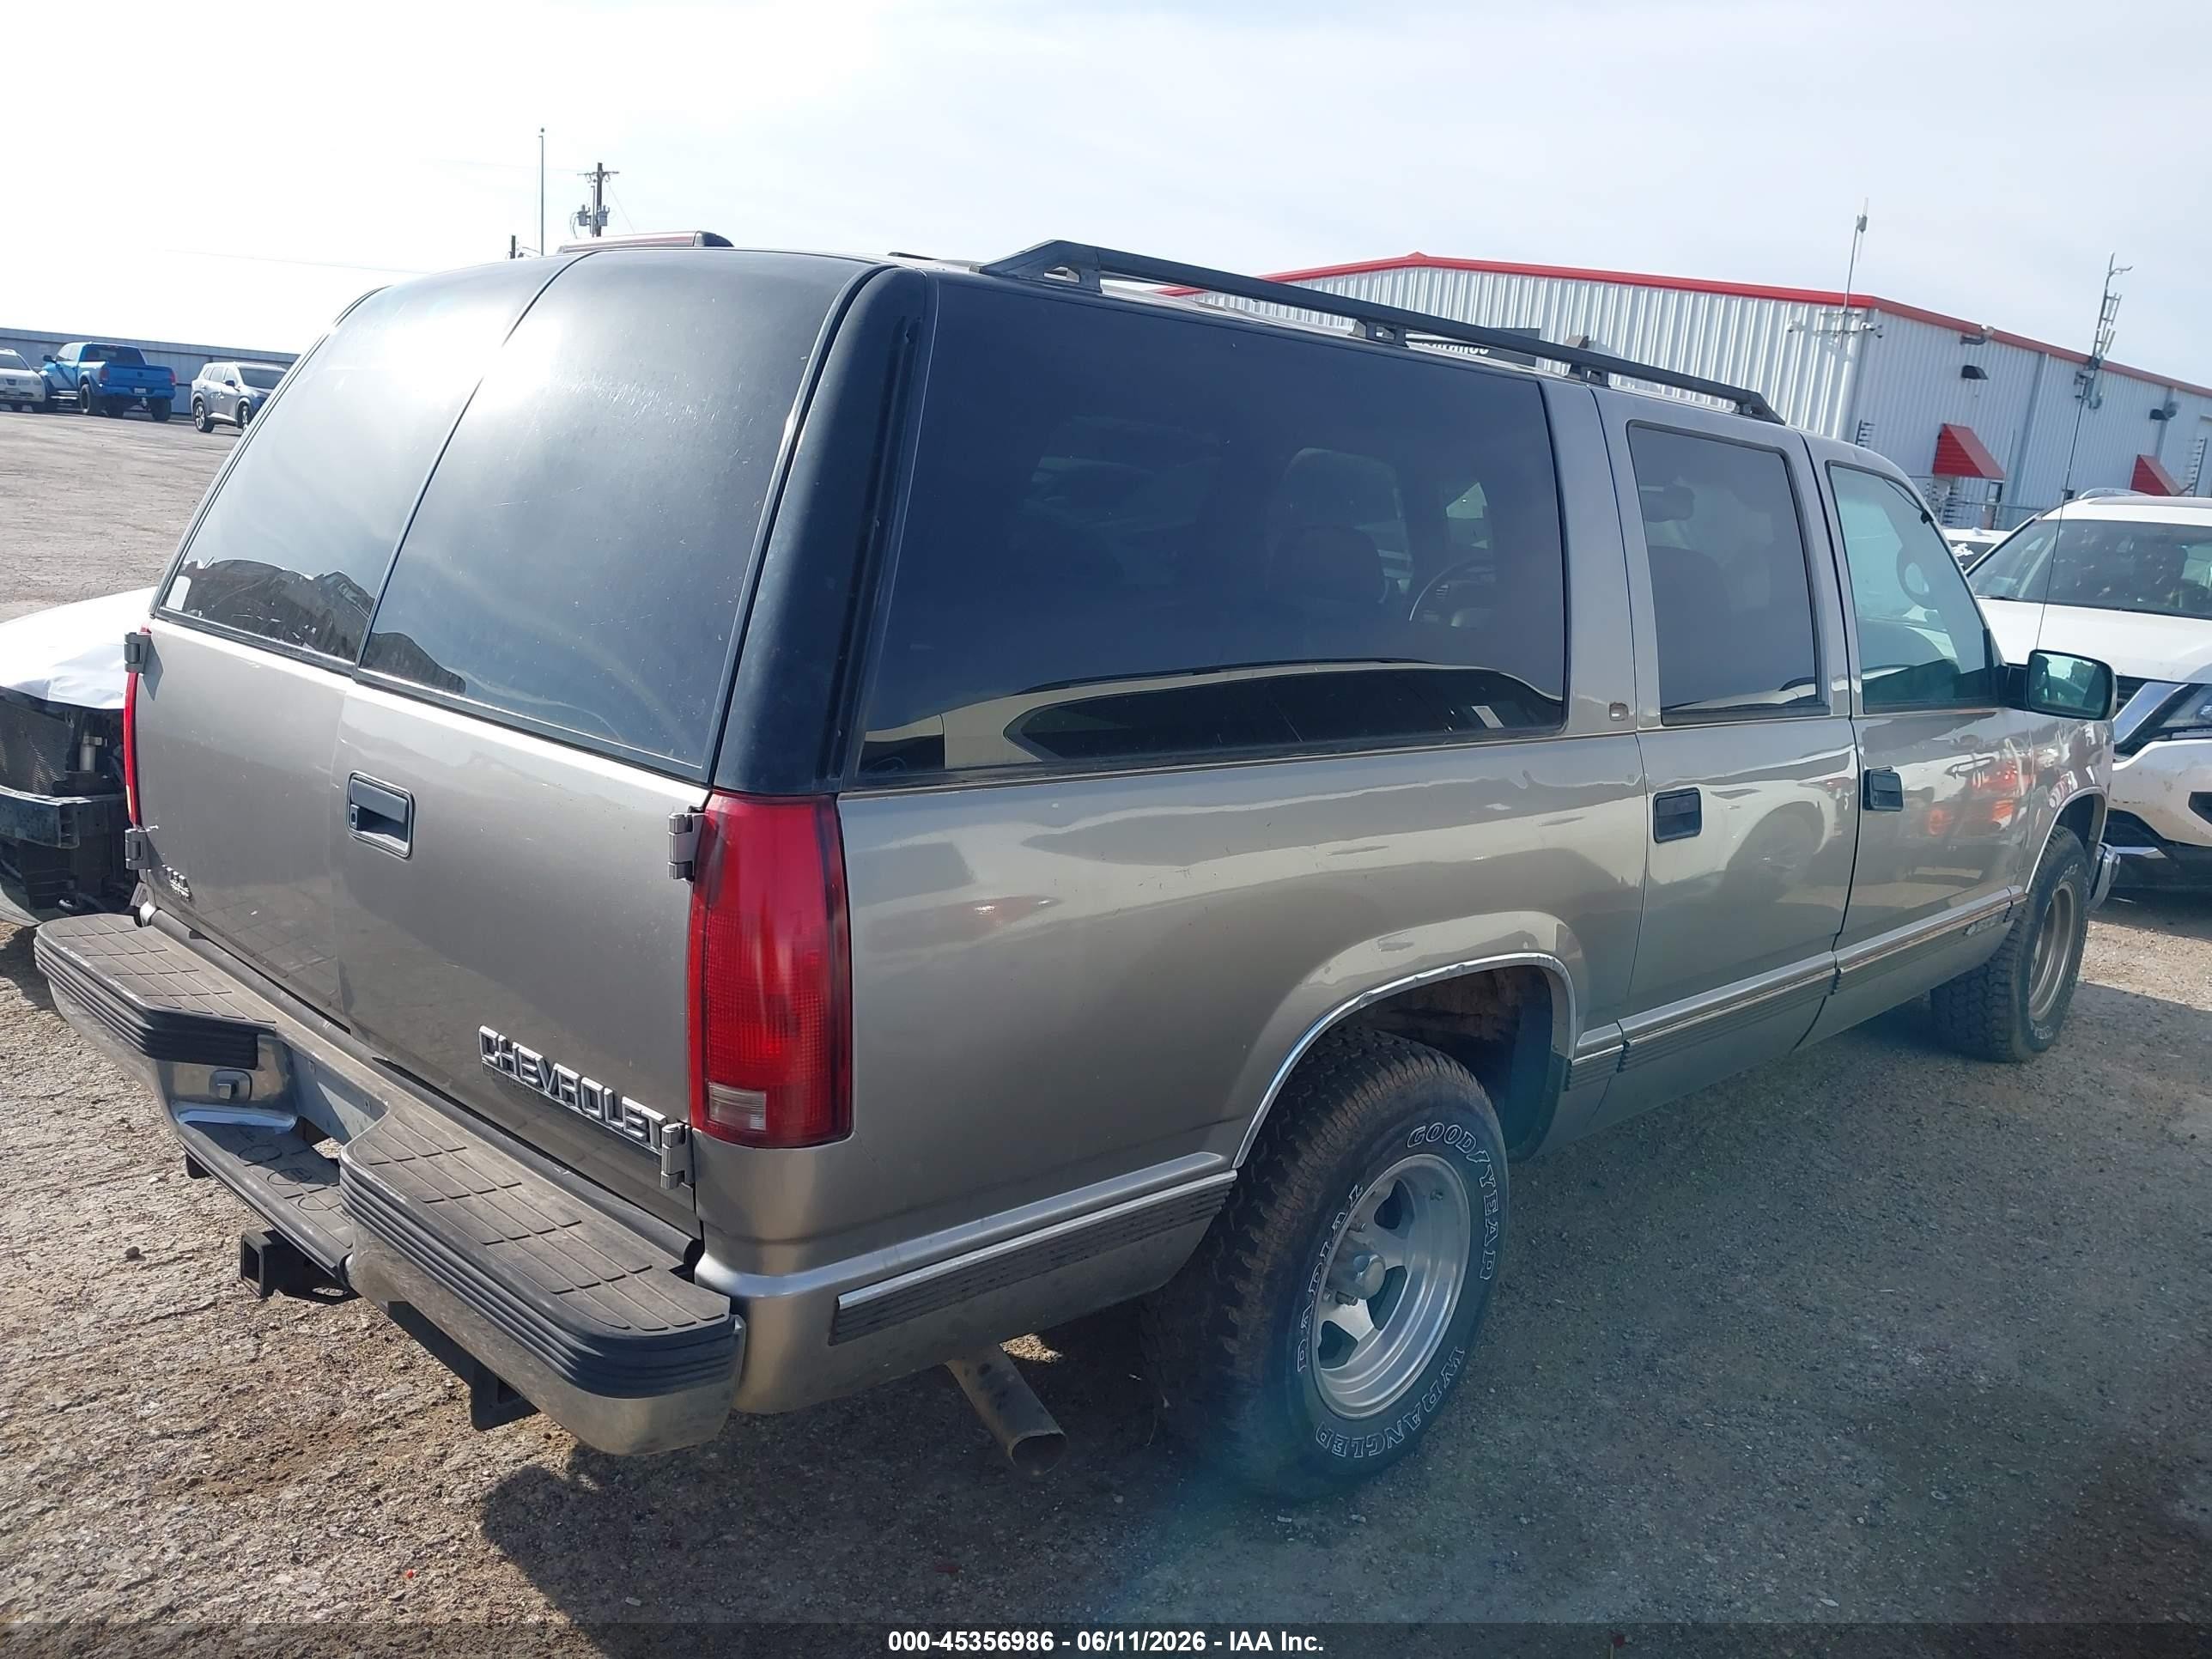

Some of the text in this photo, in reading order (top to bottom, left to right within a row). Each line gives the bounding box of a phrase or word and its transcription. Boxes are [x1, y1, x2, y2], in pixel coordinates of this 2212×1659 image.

[478, 1024, 666, 1154] CHEVROLET
[1407, 1121, 1499, 1281] GOODYEAR
[1315, 1346, 1466, 1459] WRANGLER
